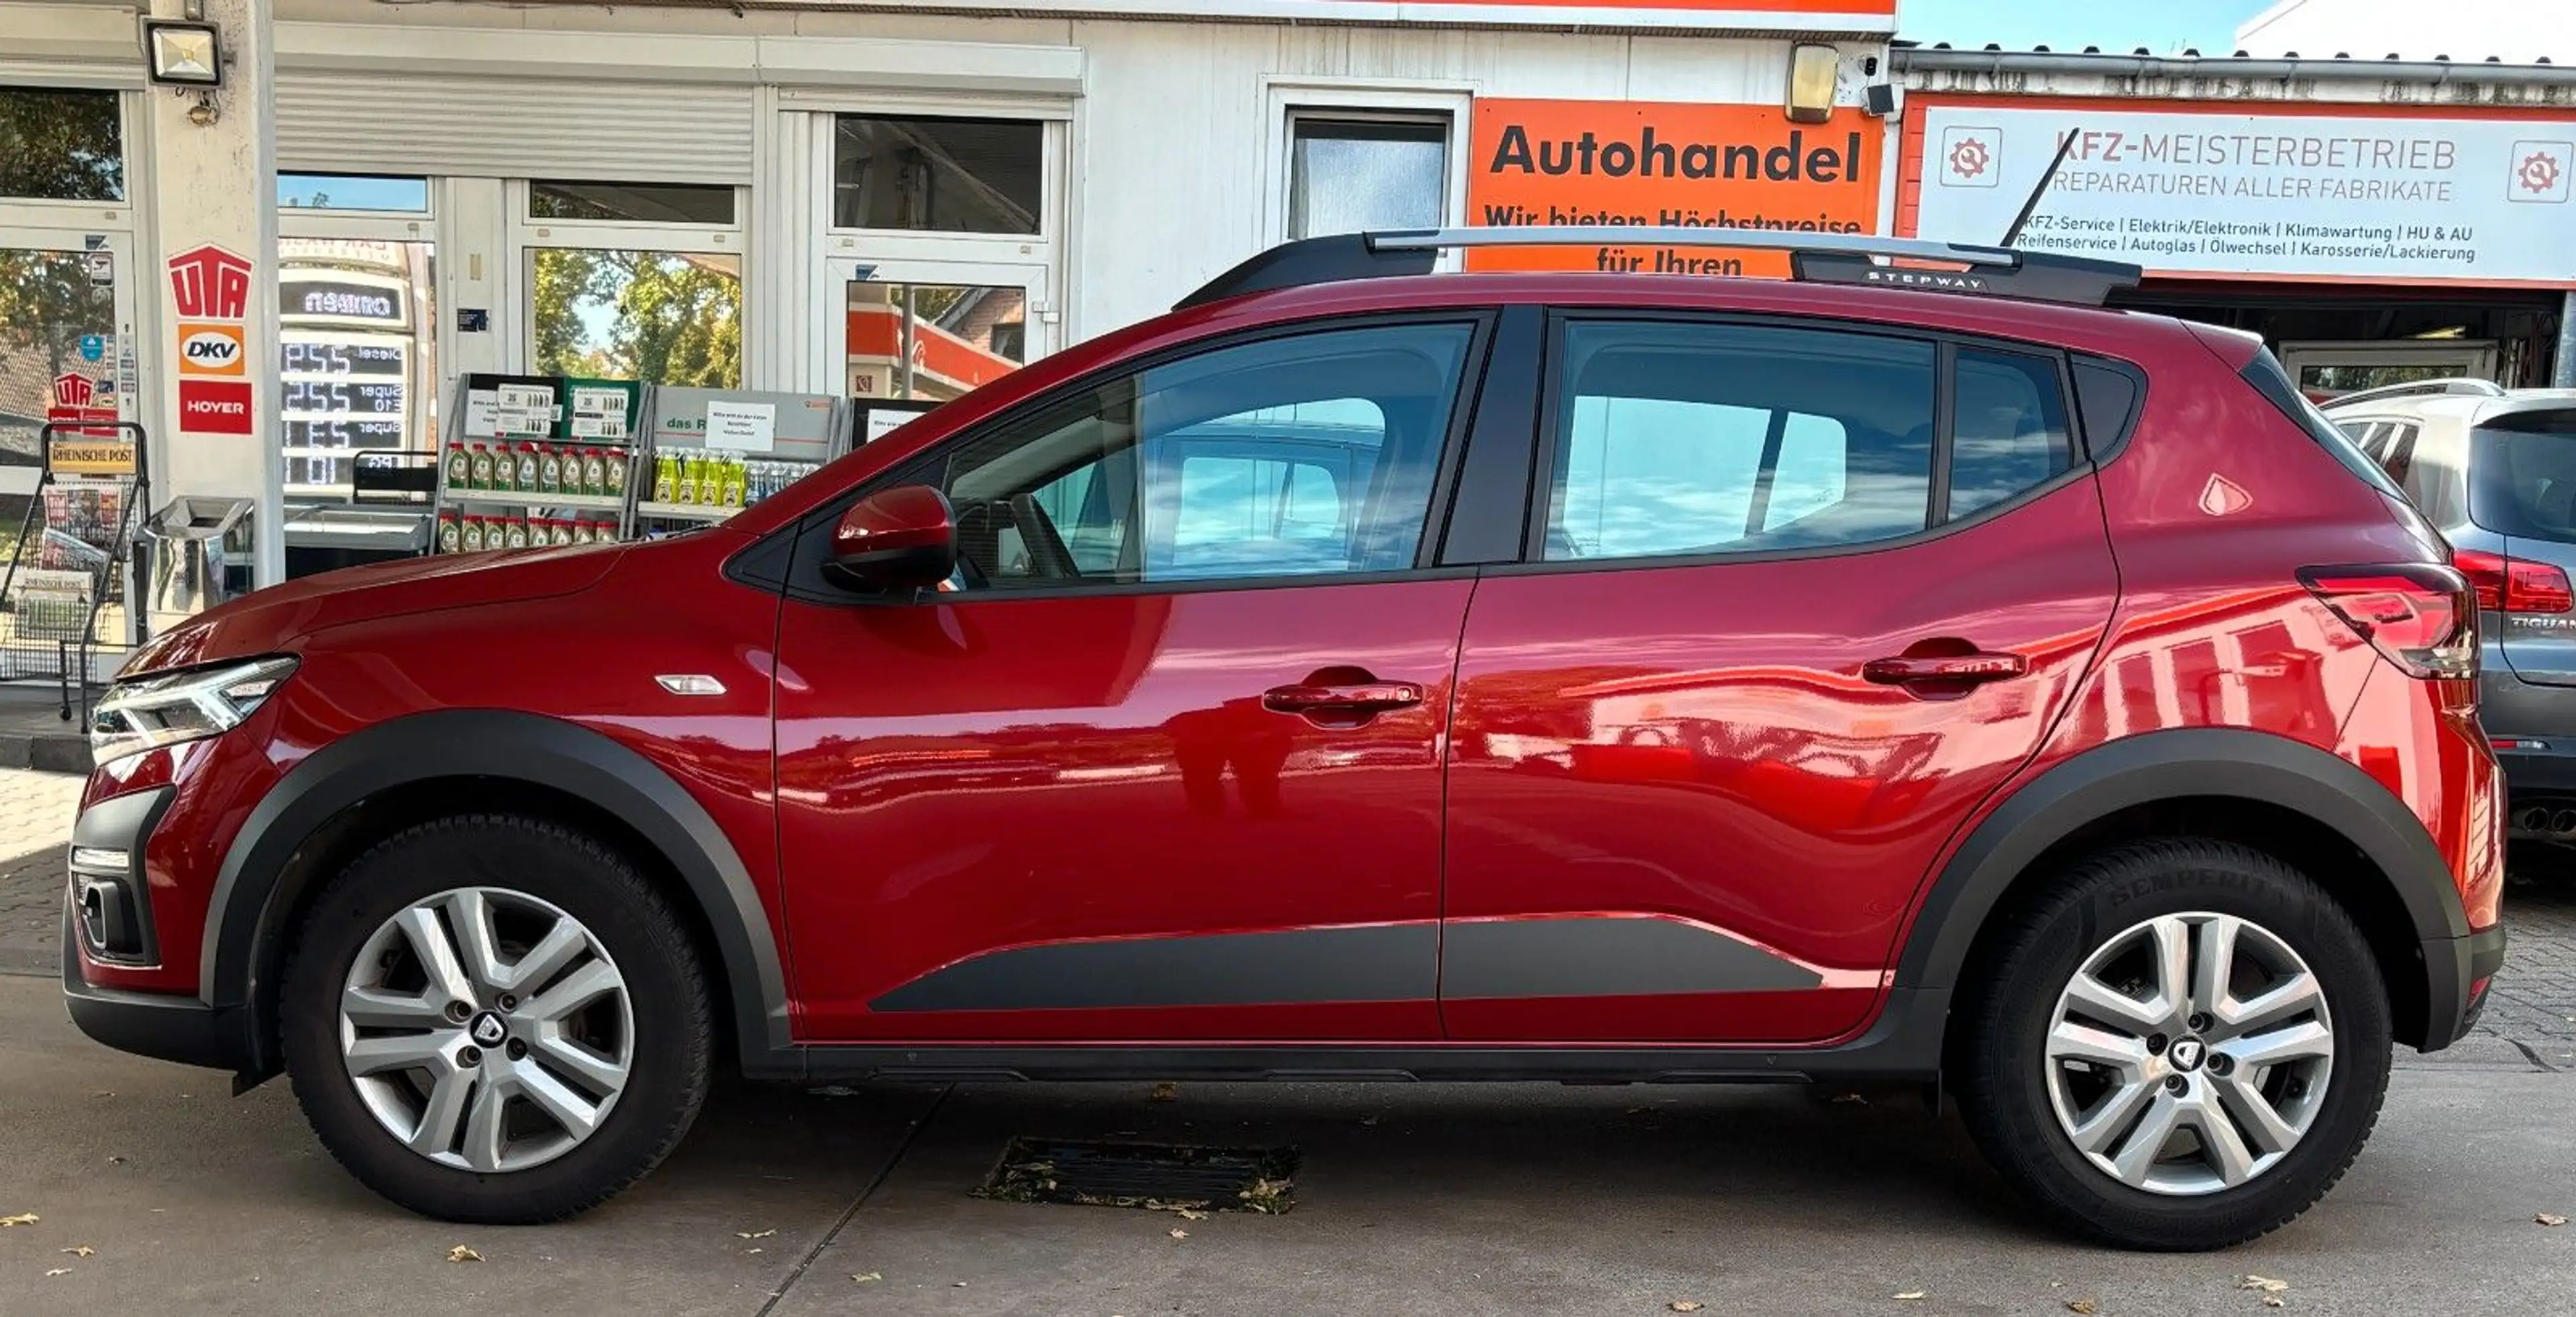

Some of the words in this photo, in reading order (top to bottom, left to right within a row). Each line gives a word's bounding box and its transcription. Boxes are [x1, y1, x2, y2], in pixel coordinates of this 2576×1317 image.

[1490, 125, 1861, 182] Autohandel
[2056, 131, 2455, 169] KFZ-MEISTERBETRIEB
[2053, 172, 2226, 196] REPARATUREN
[2234, 176, 2312, 199] ALLER
[2319, 178, 2453, 202] FABRIKATE
[1485, 204, 1538, 227] Wir
[1550, 205, 1647, 227] bieten
[2025, 215, 2114, 232] KFZ-Service
[2129, 218, 2271, 237] Elektrik/Elektronik
[2285, 222, 2392, 242] Klimawartung
[2407, 226, 2430, 240] HU
[2434, 227, 2446, 240] &
[2451, 227, 2473, 242] AU
[1597, 247, 1644, 271] für
[1654, 249, 1742, 276] Ihren
[2017, 232, 2117, 251] Reifenservice
[2130, 237, 2196, 256] Autoglas
[2209, 238, 2286, 256] Ölwechsel
[2300, 242, 2476, 263] Karosserie/Lackierung
[169, 246, 252, 318] UTA
[1868, 272, 1981, 288] STEPWAY
[187, 341, 237, 358] DKV
[56, 373, 93, 406] UTA
[187, 400, 245, 415] HOYER
[667, 418, 692, 429] das
[53, 448, 107, 462] RHEINISCHE
[109, 448, 133, 462] POST
